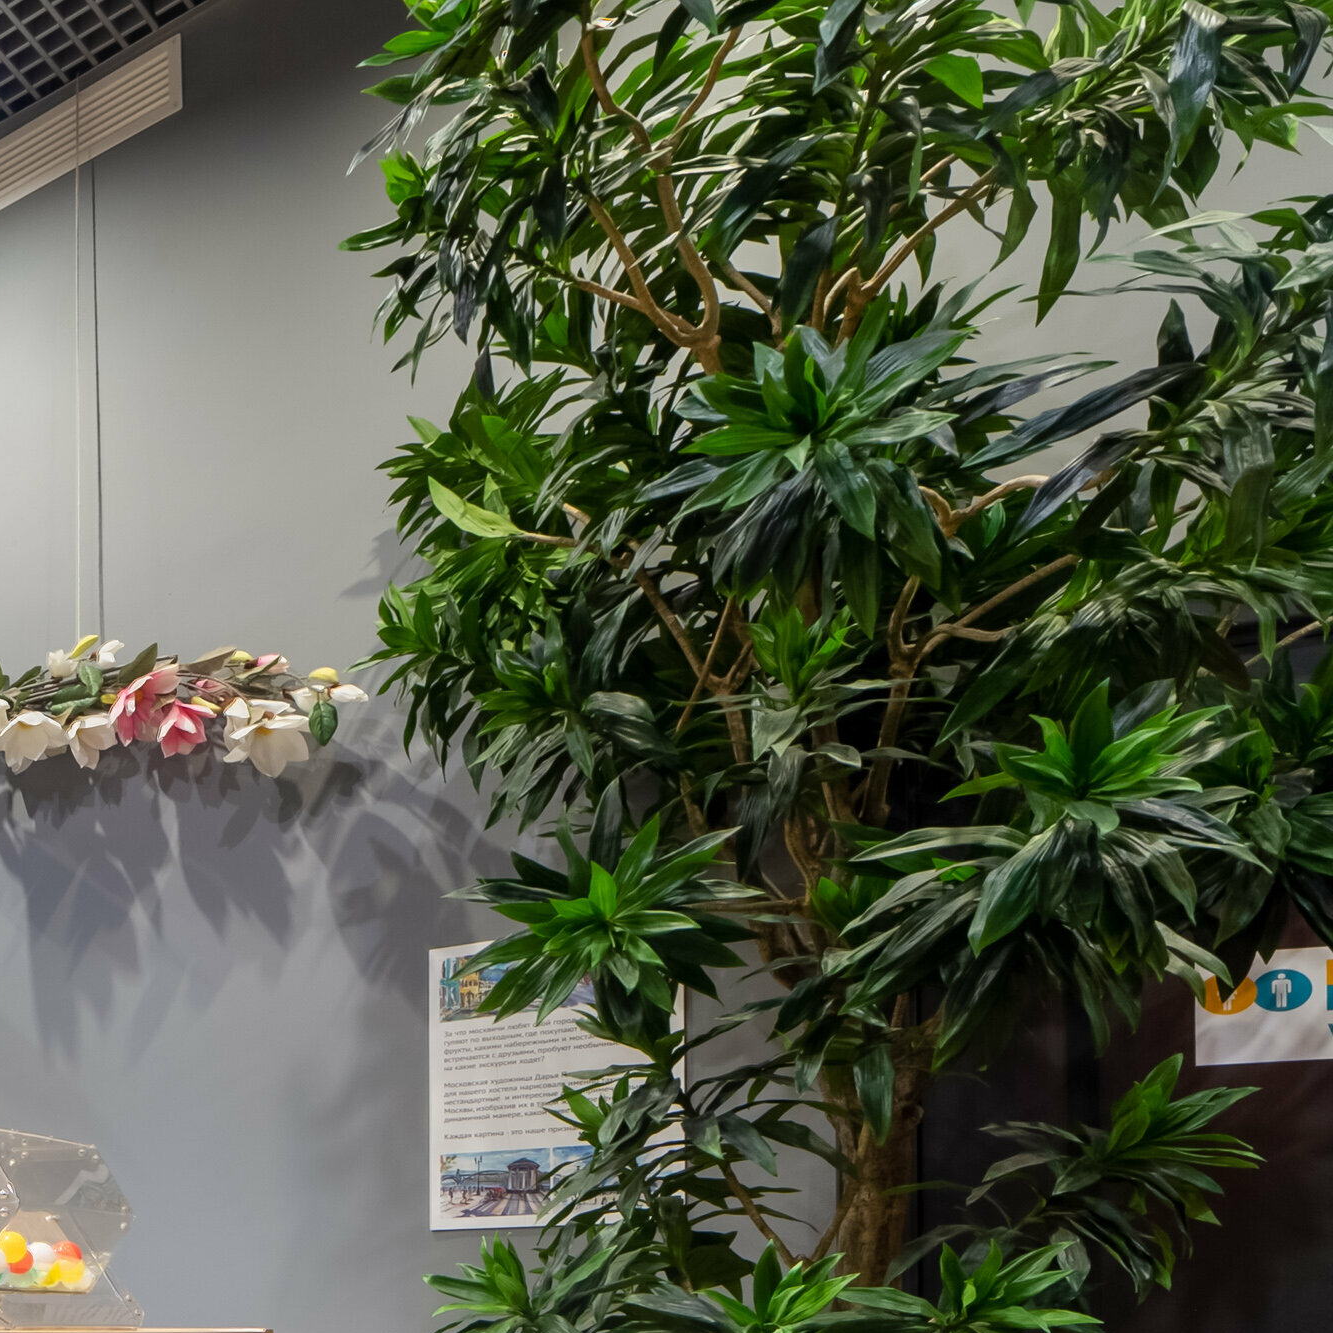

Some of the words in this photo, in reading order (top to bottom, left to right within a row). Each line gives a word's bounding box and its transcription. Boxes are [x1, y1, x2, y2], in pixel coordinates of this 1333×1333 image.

[507, 1022, 530, 1030] любят
[540, 1027, 578, 1036] покупают
[537, 1045, 571, 1054] пробуют
[479, 1060, 517, 1068] экскурсии
[444, 1080, 488, 1088] Московская
[490, 1076, 533, 1084] художница
[535, 1073, 558, 1081] Дарья
